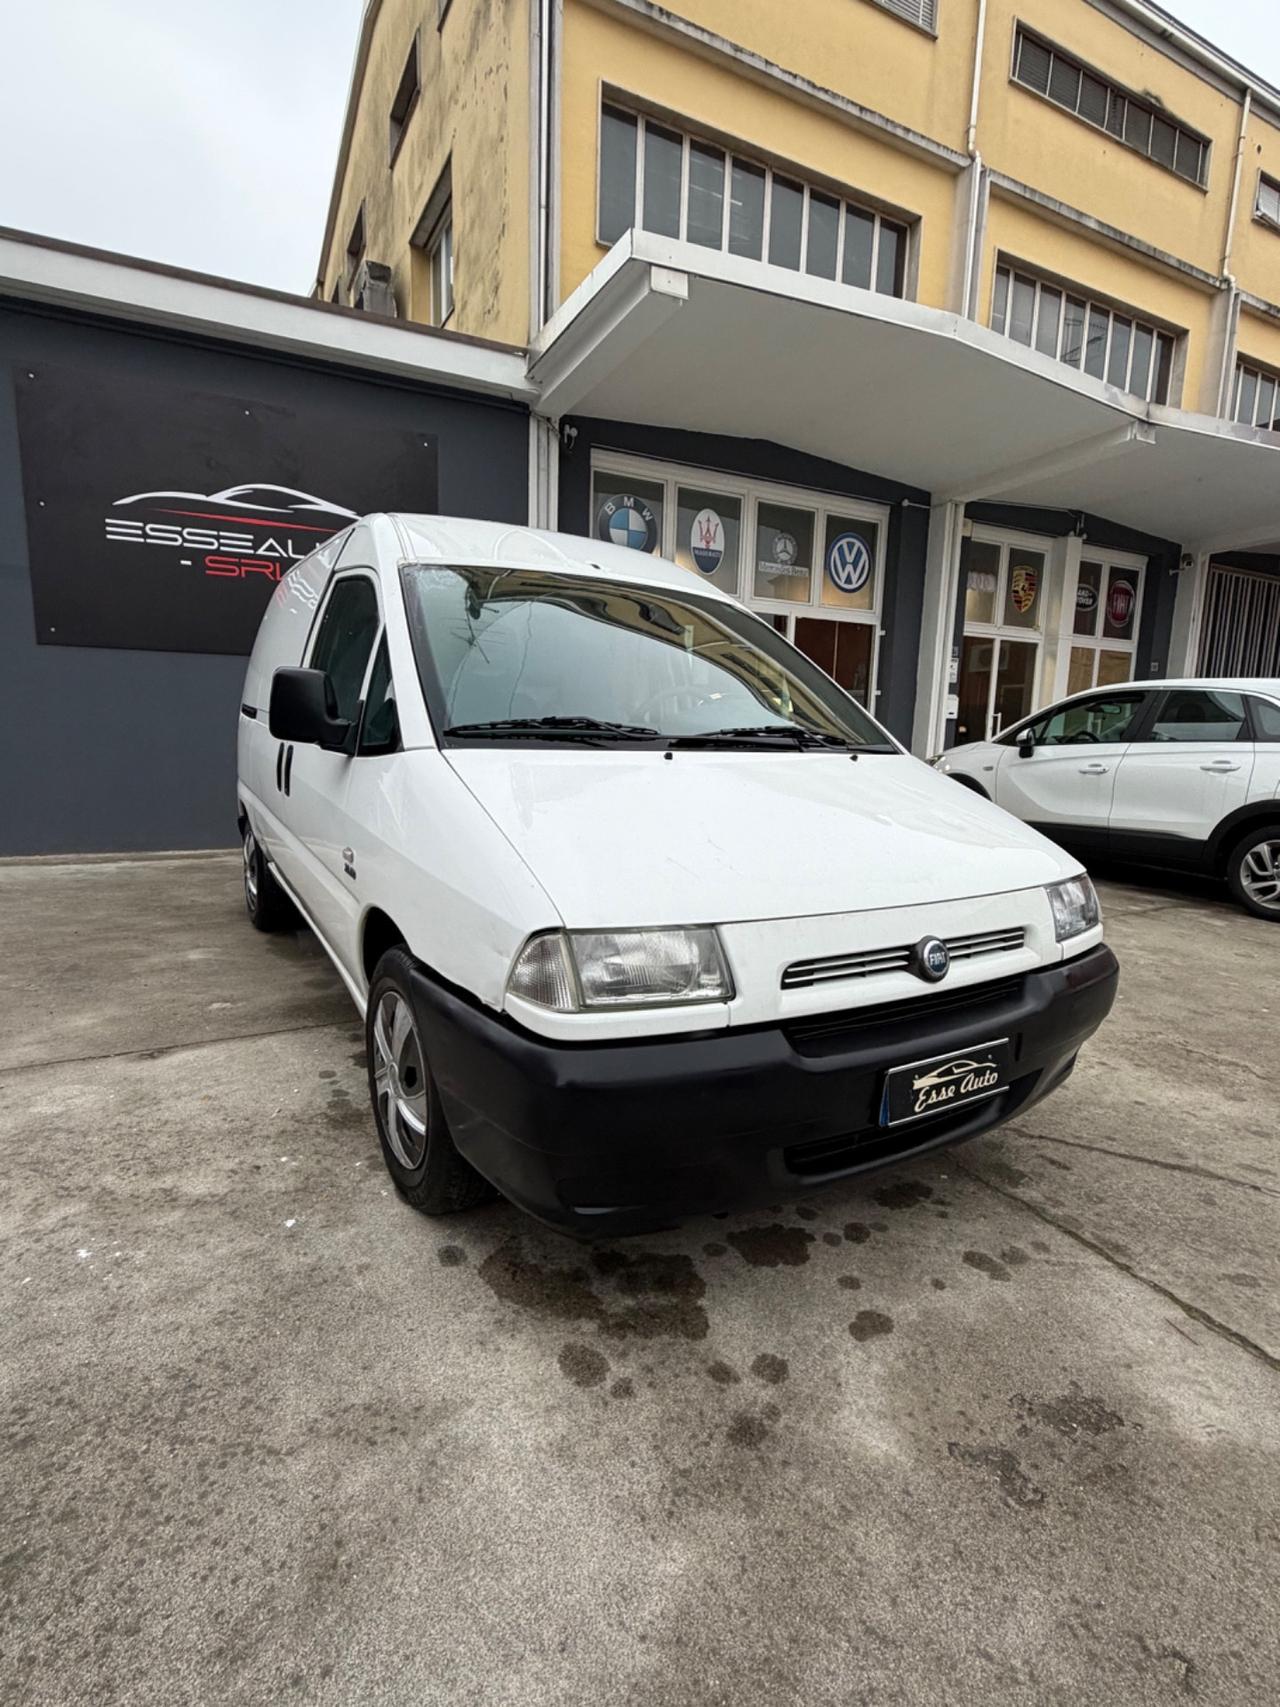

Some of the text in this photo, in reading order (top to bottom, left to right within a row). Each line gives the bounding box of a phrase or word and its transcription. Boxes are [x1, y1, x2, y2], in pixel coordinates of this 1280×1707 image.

[604, 495, 653, 521] BMW
[105, 518, 320, 559] ESSEAU
[914, 1069, 999, 1113] Esse Auto
